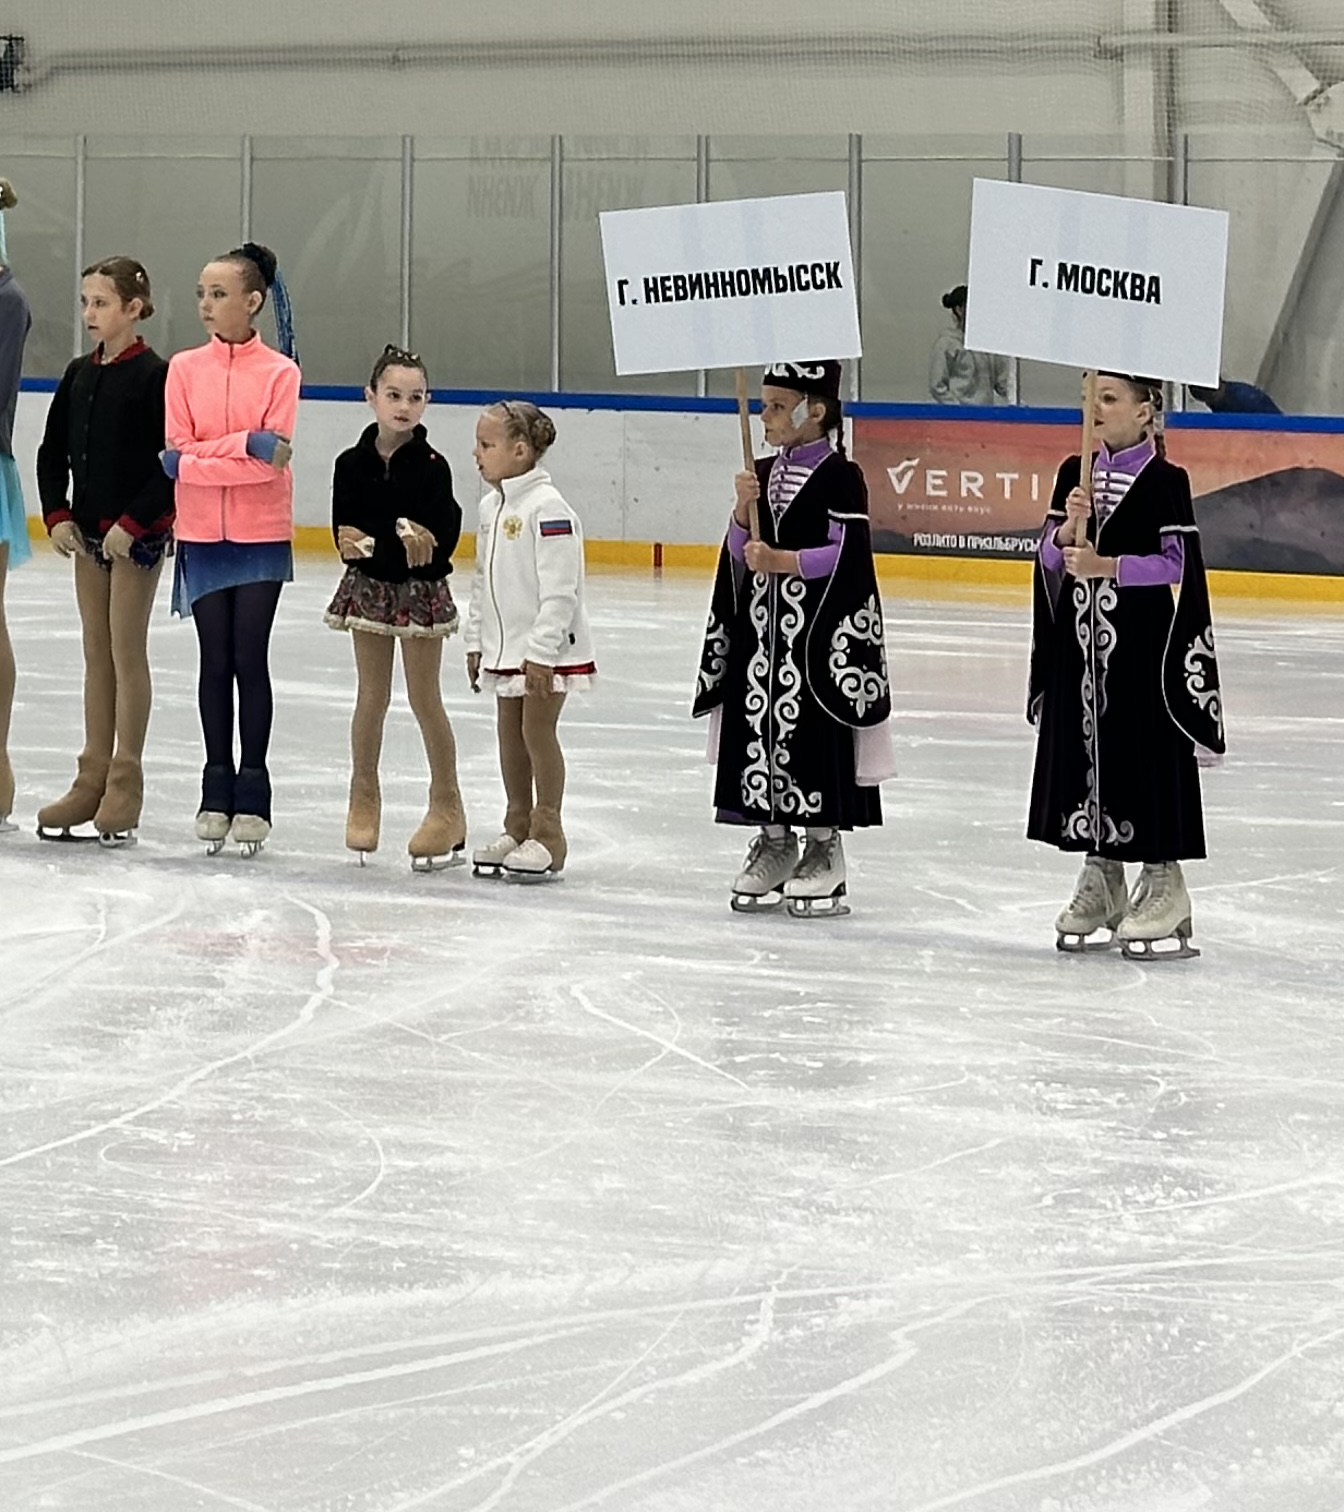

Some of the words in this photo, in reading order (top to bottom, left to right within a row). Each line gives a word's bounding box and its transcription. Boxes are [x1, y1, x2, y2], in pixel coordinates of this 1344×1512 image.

[617, 279, 639, 306] Г.
[643, 261, 843, 305] НЕВИННОМЫССК
[1029, 258, 1049, 288] Г.
[1057, 262, 1161, 305] МОСКВА
[887, 458, 1056, 501] VERTI
